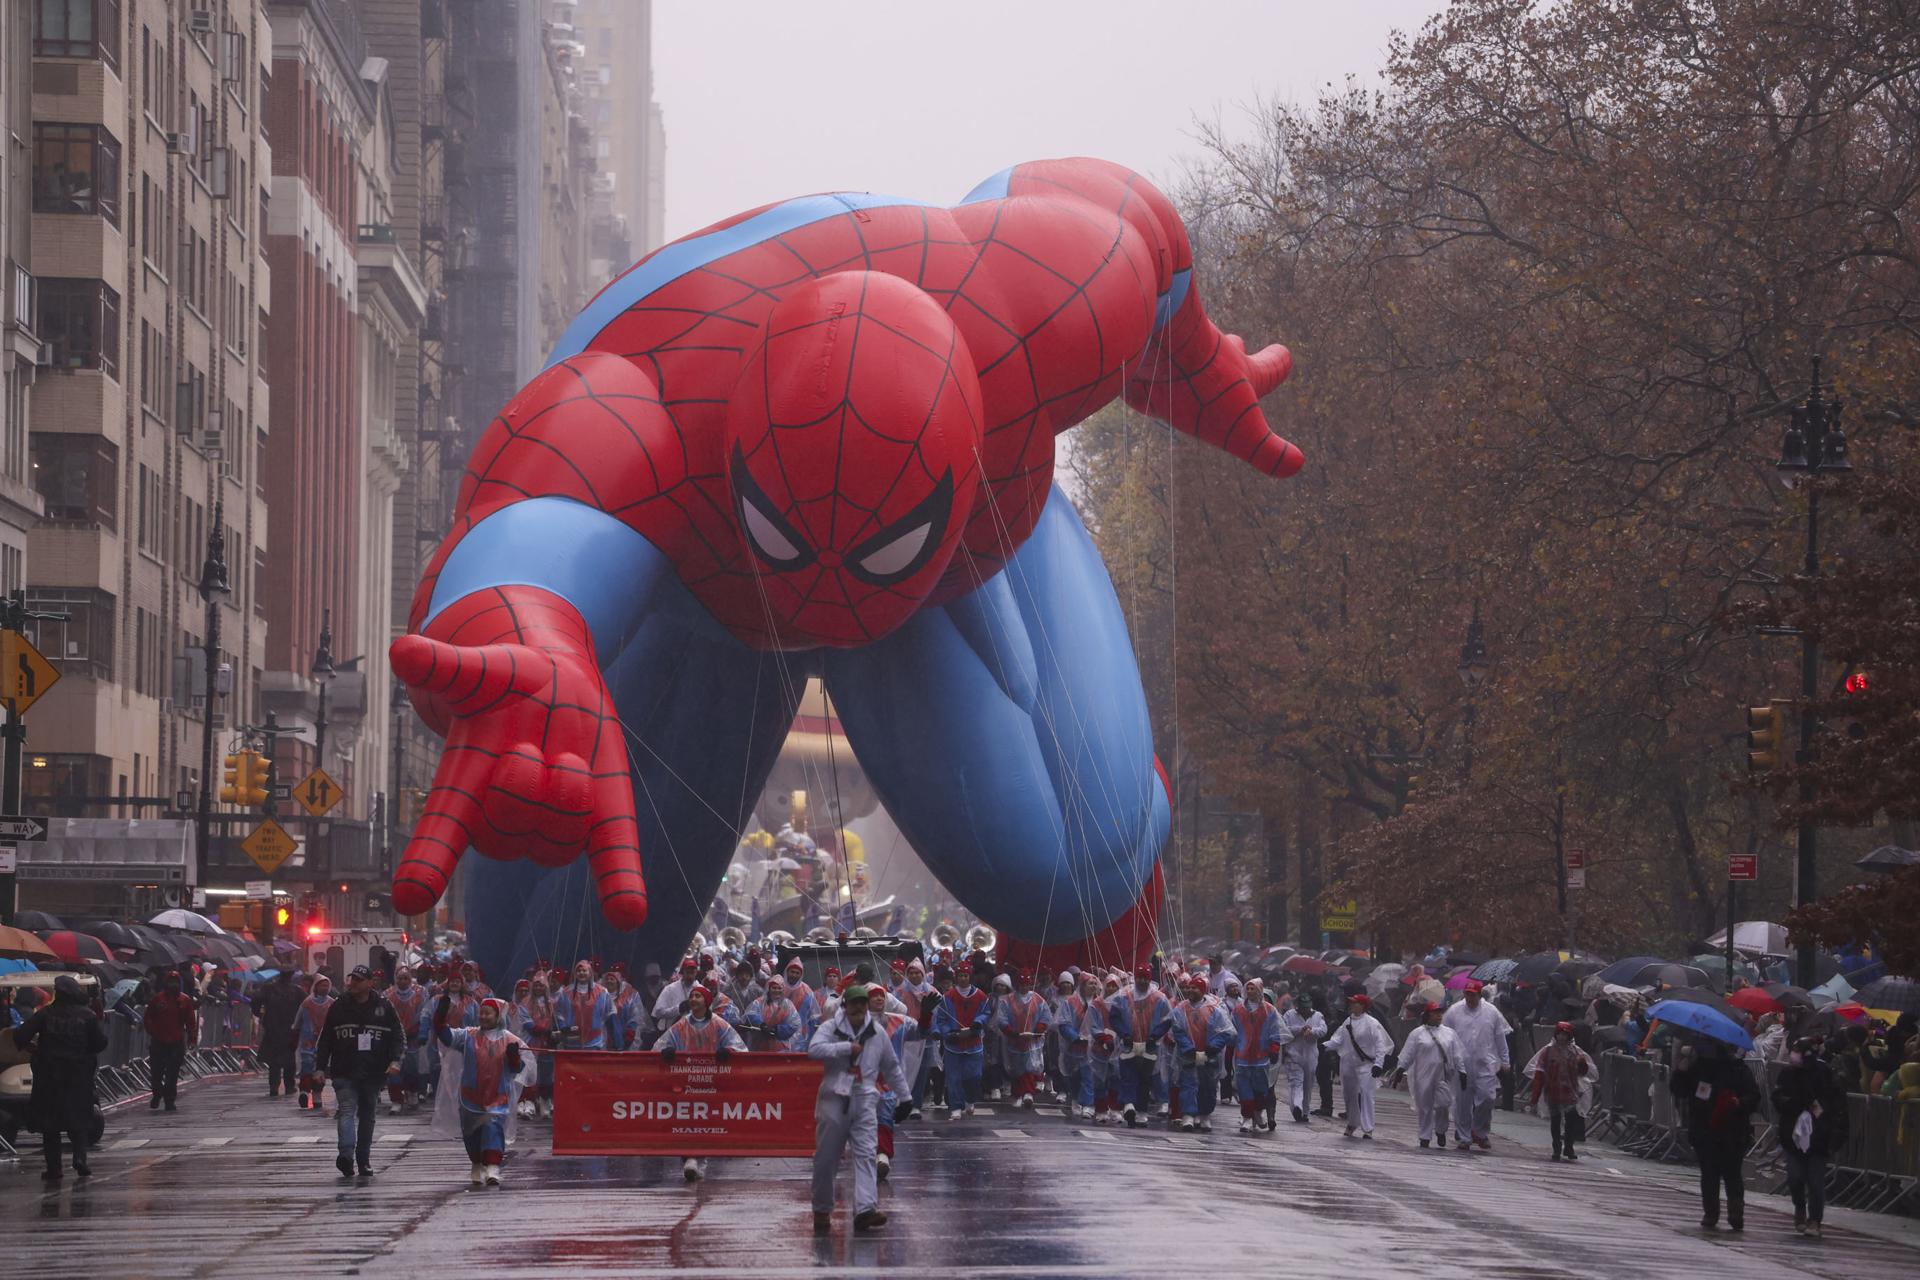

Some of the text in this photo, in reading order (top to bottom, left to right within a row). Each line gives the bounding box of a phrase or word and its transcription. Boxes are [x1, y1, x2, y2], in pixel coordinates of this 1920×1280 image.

[13, 823, 37, 834] WAY
[258, 853, 280, 861] AHEAD
[670, 1066, 732, 1074] THANKSGIVING DAY
[687, 1074, 713, 1083] PARADE
[684, 1085, 717, 1095] Presents
[612, 1101, 782, 1121] SPIDER-MAN
